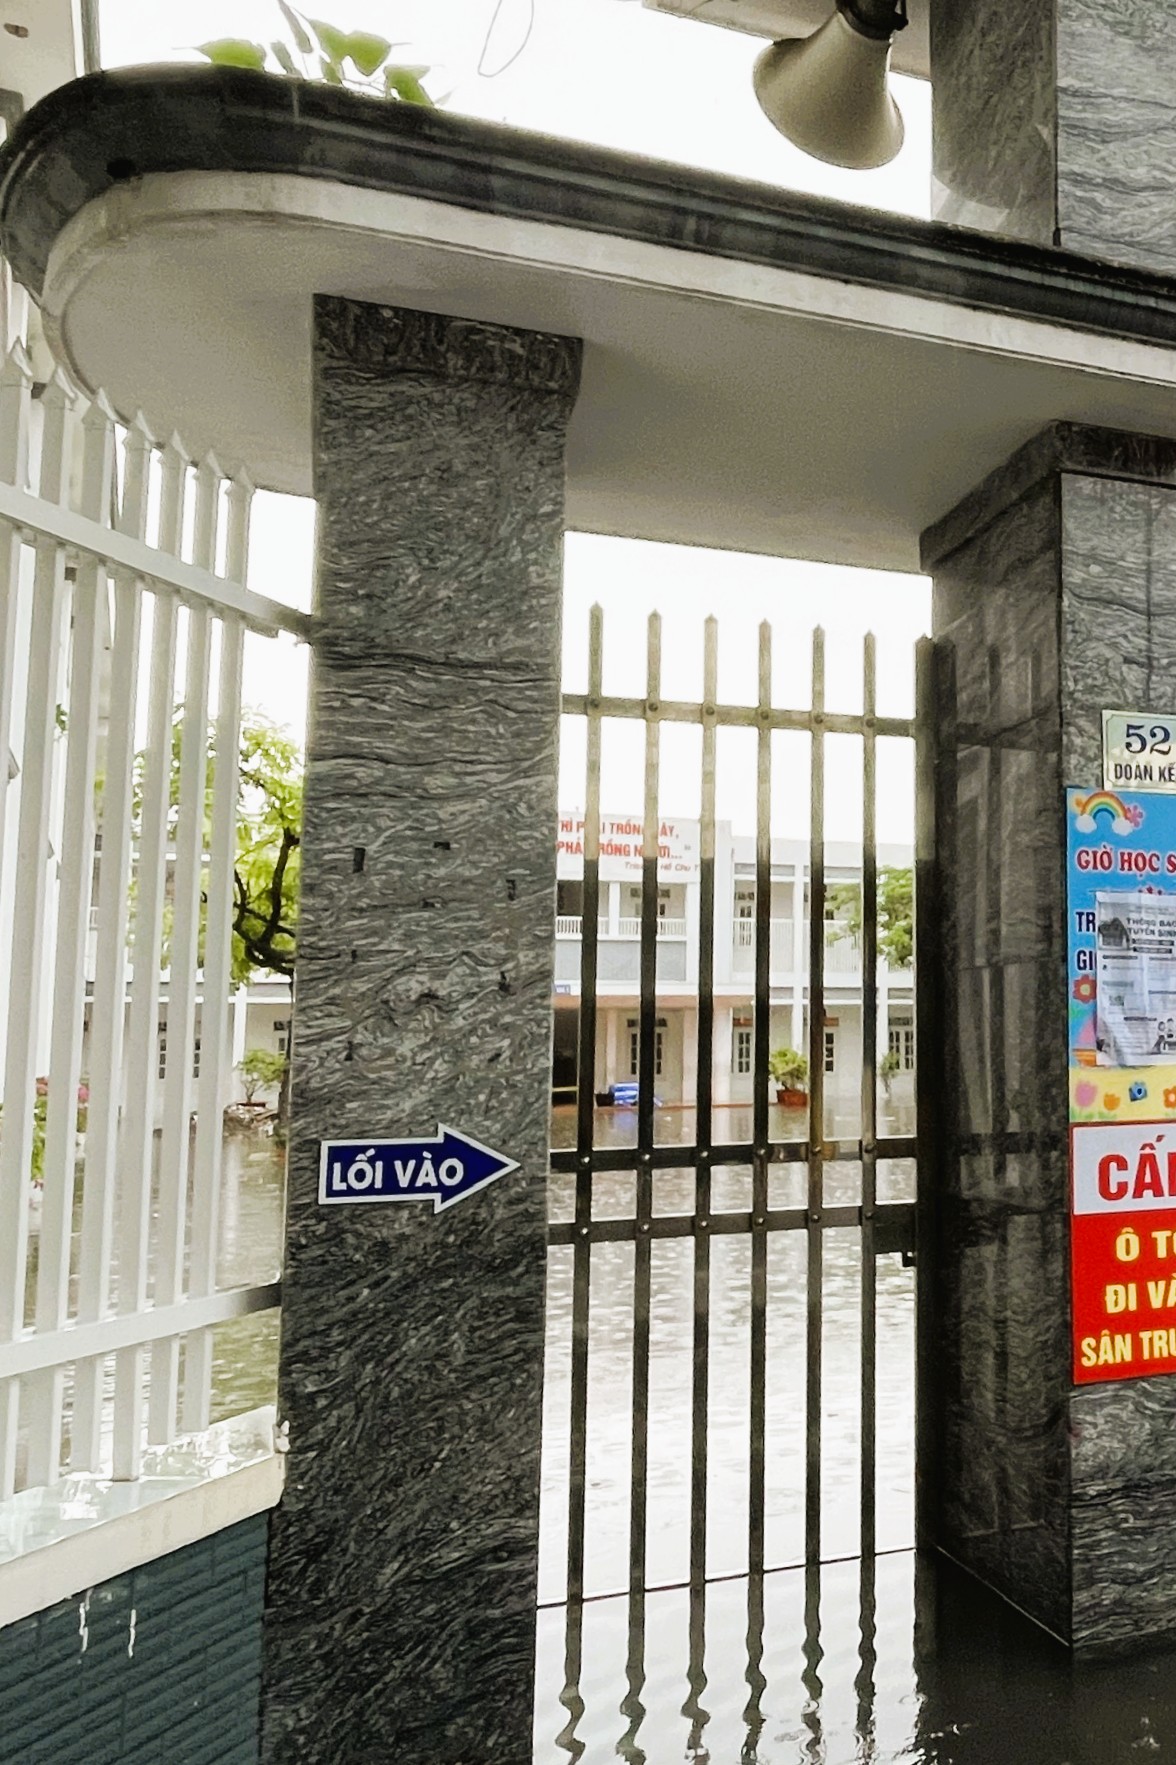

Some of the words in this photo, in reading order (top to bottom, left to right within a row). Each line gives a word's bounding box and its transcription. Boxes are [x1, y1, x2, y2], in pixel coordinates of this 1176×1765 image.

[1125, 723, 1172, 755] 52
[1077, 844, 1113, 872] GIỜ
[1119, 851, 1160, 878] HỌC
[332, 1148, 383, 1191] LỐI
[393, 1150, 465, 1188] VÀO
[1115, 1226, 1140, 1262] Ô
[1104, 1283, 1137, 1314] ĐI
[1081, 1328, 1133, 1368] SÂN
